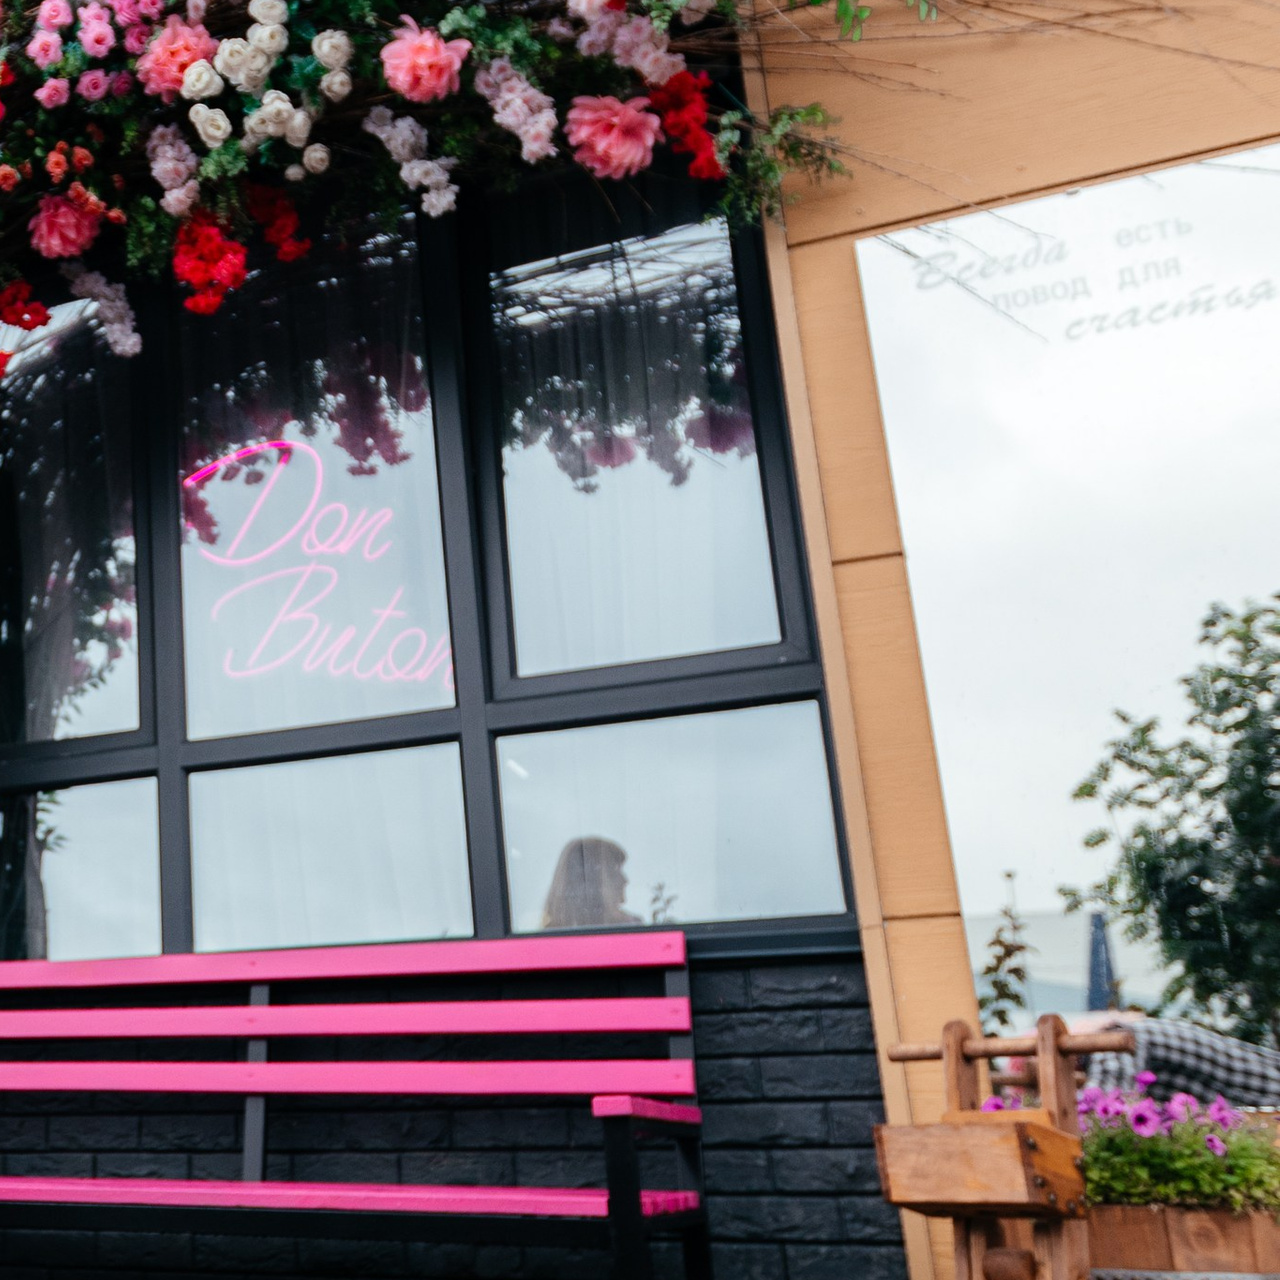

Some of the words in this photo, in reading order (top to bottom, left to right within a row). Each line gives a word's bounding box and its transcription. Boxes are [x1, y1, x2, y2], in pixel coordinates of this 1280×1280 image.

[912, 237, 1070, 291] Всегда
[1114, 217, 1194, 248] есть
[992, 276, 1094, 312] повод
[1117, 256, 1183, 291] для
[183, 440, 394, 565] Don
